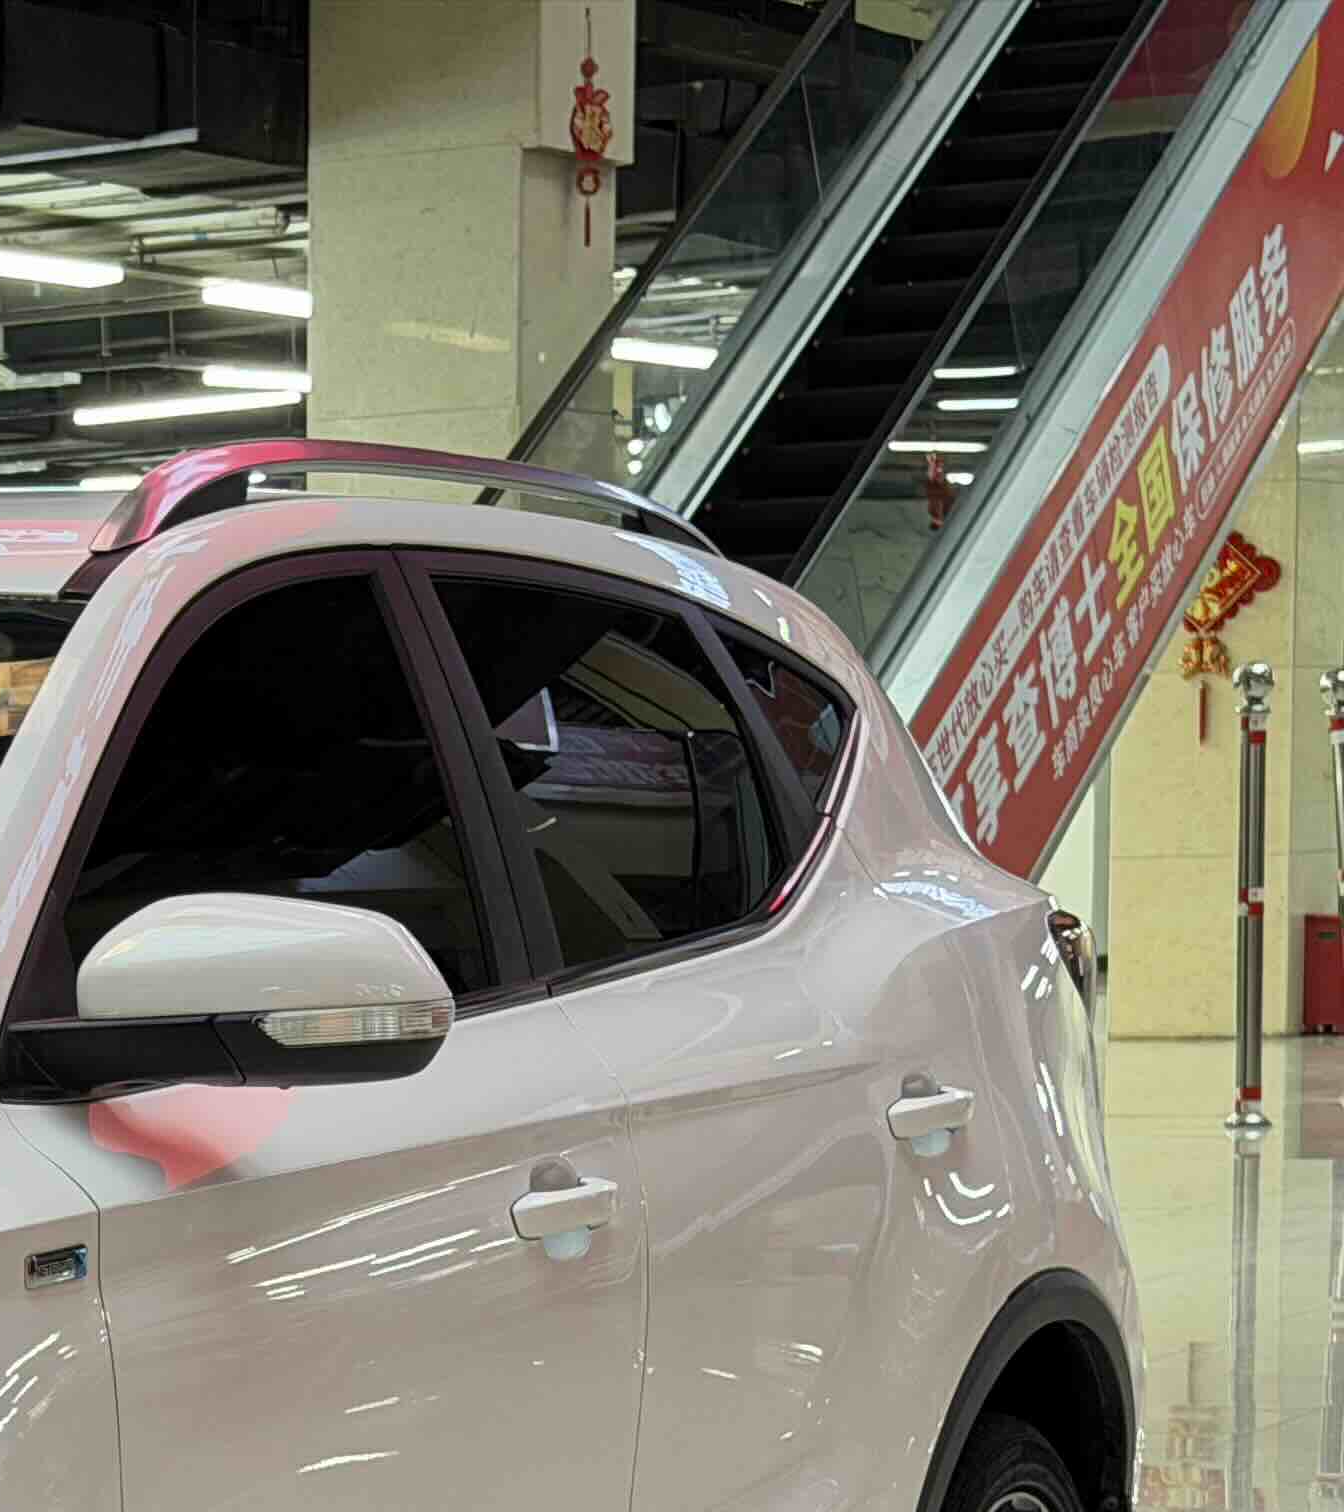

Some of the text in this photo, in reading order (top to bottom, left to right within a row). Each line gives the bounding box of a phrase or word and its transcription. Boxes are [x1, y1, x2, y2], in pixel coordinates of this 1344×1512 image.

[949, 223, 1290, 846] 享查博士全国保修服务
